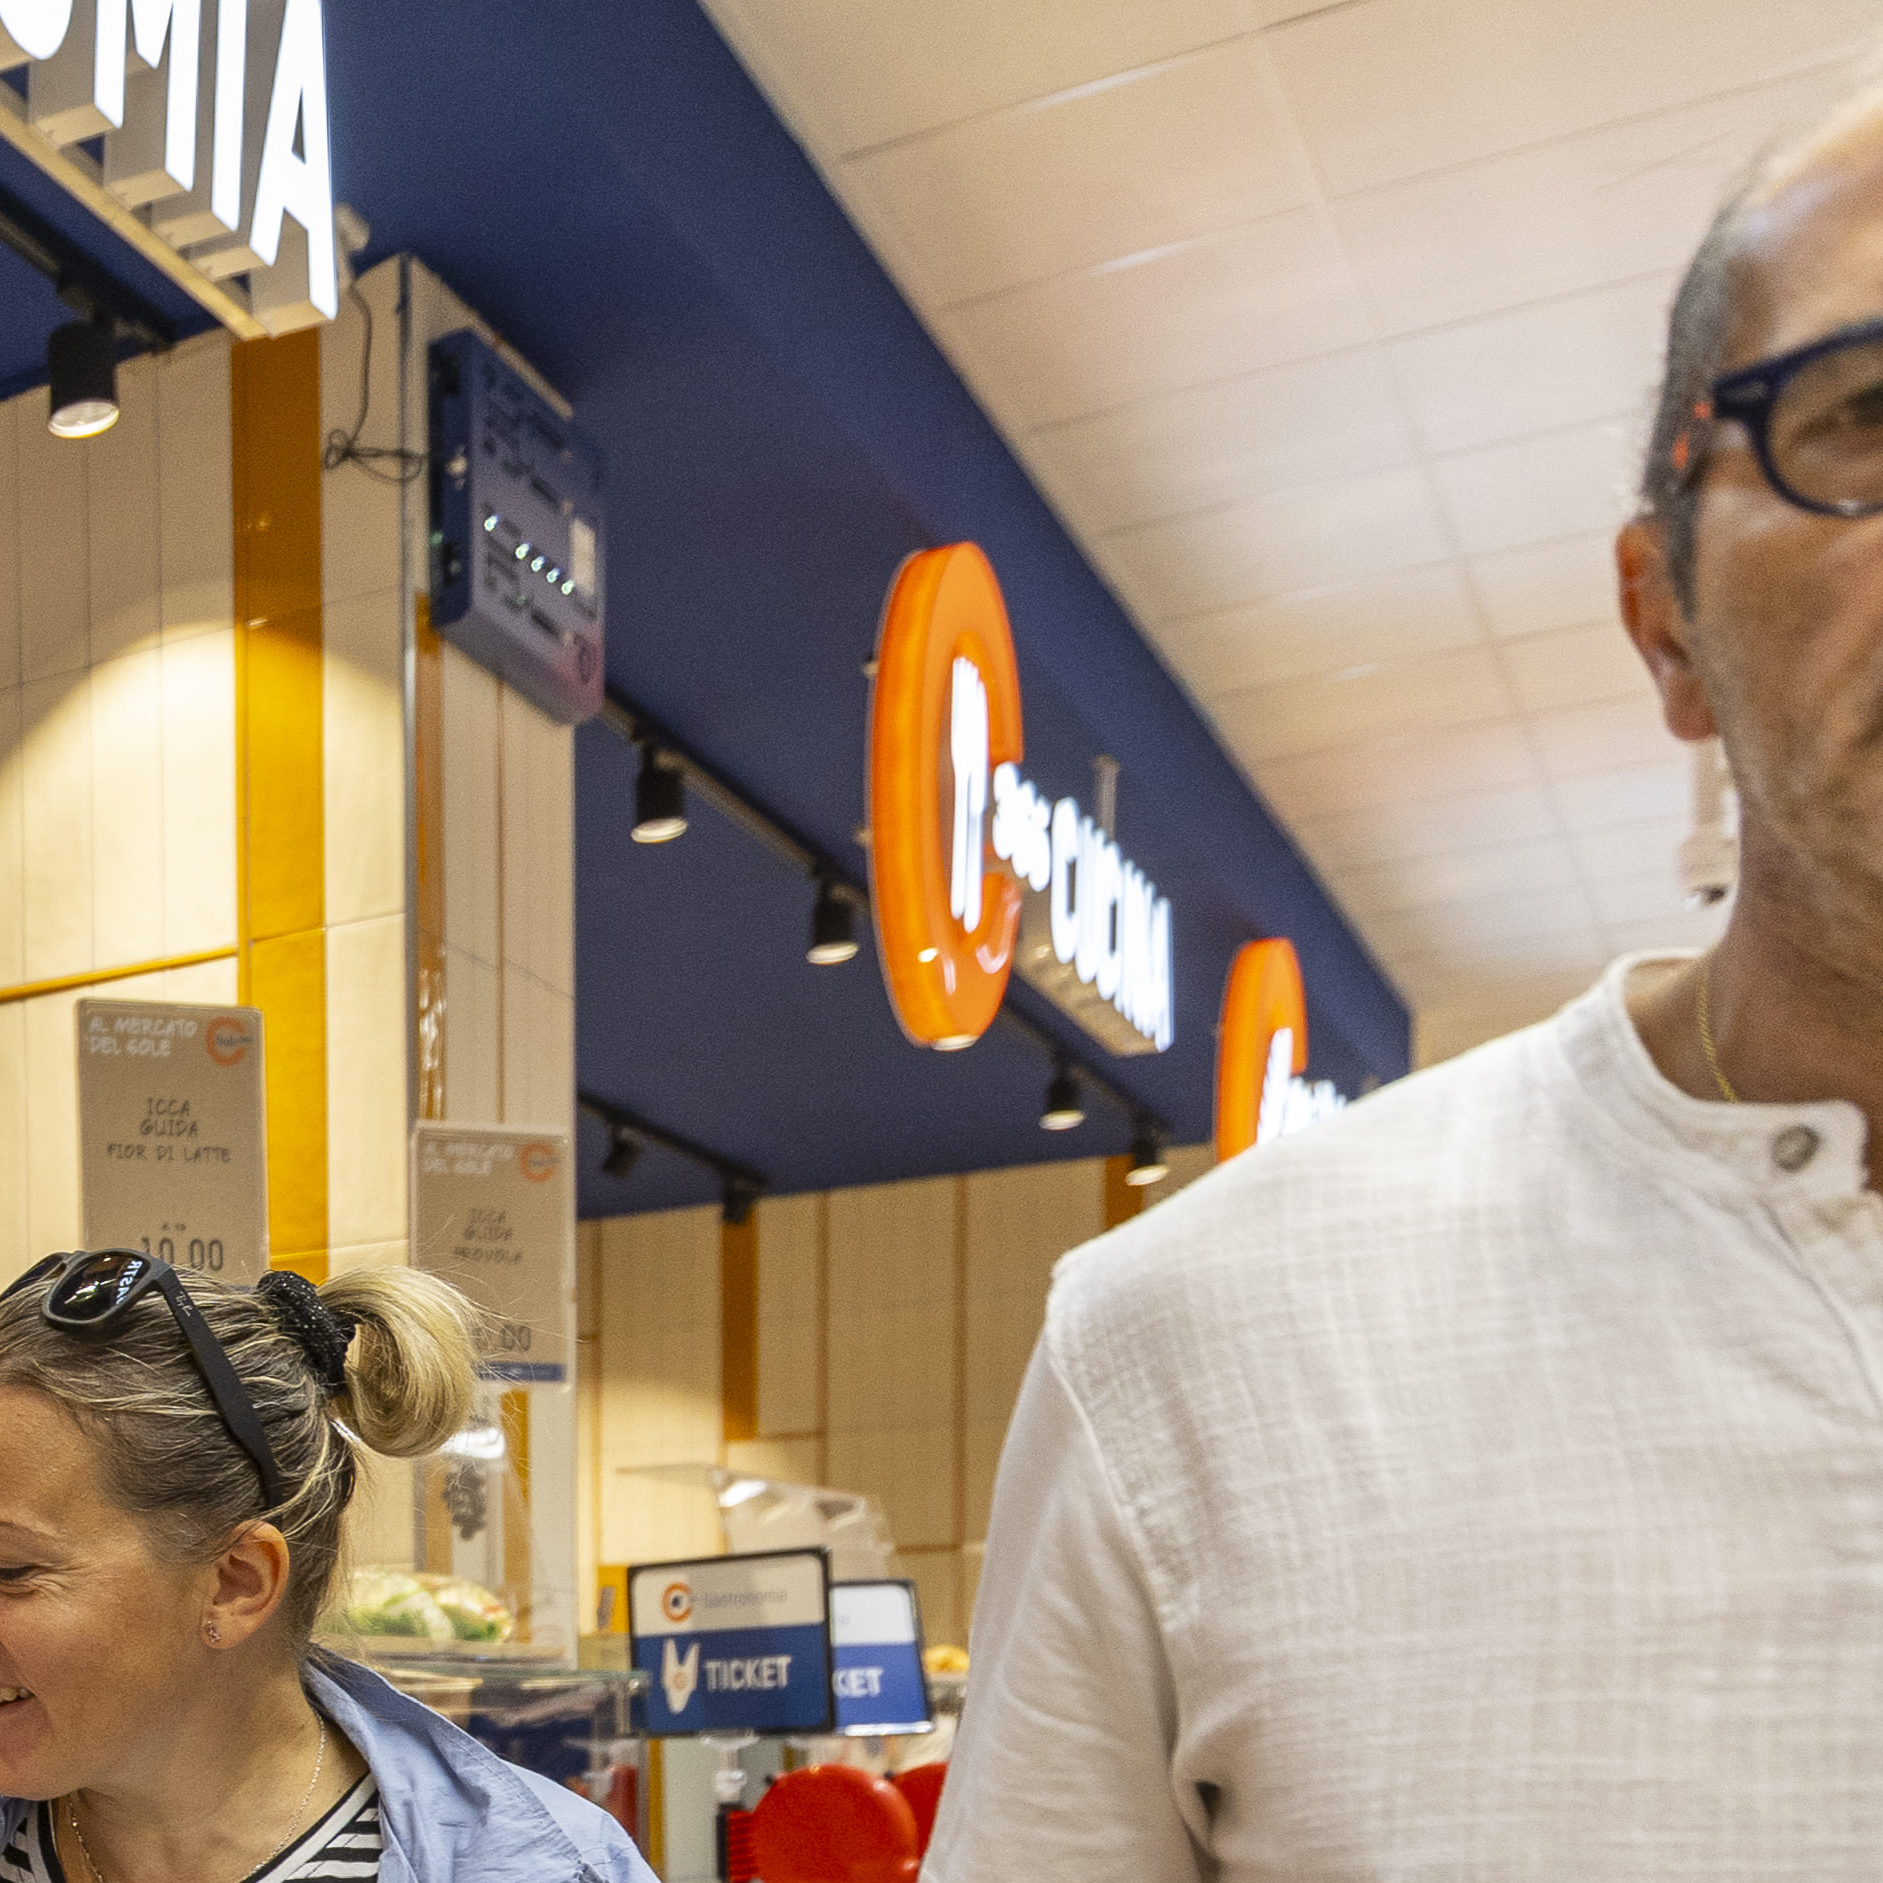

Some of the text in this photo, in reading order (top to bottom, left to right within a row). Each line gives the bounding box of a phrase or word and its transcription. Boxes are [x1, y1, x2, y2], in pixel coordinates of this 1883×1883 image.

[140, 1118, 199, 1138] GUIDA
[107, 1143, 231, 1164] FIOR DI LATTE
[704, 1655, 792, 1692] TICKET
